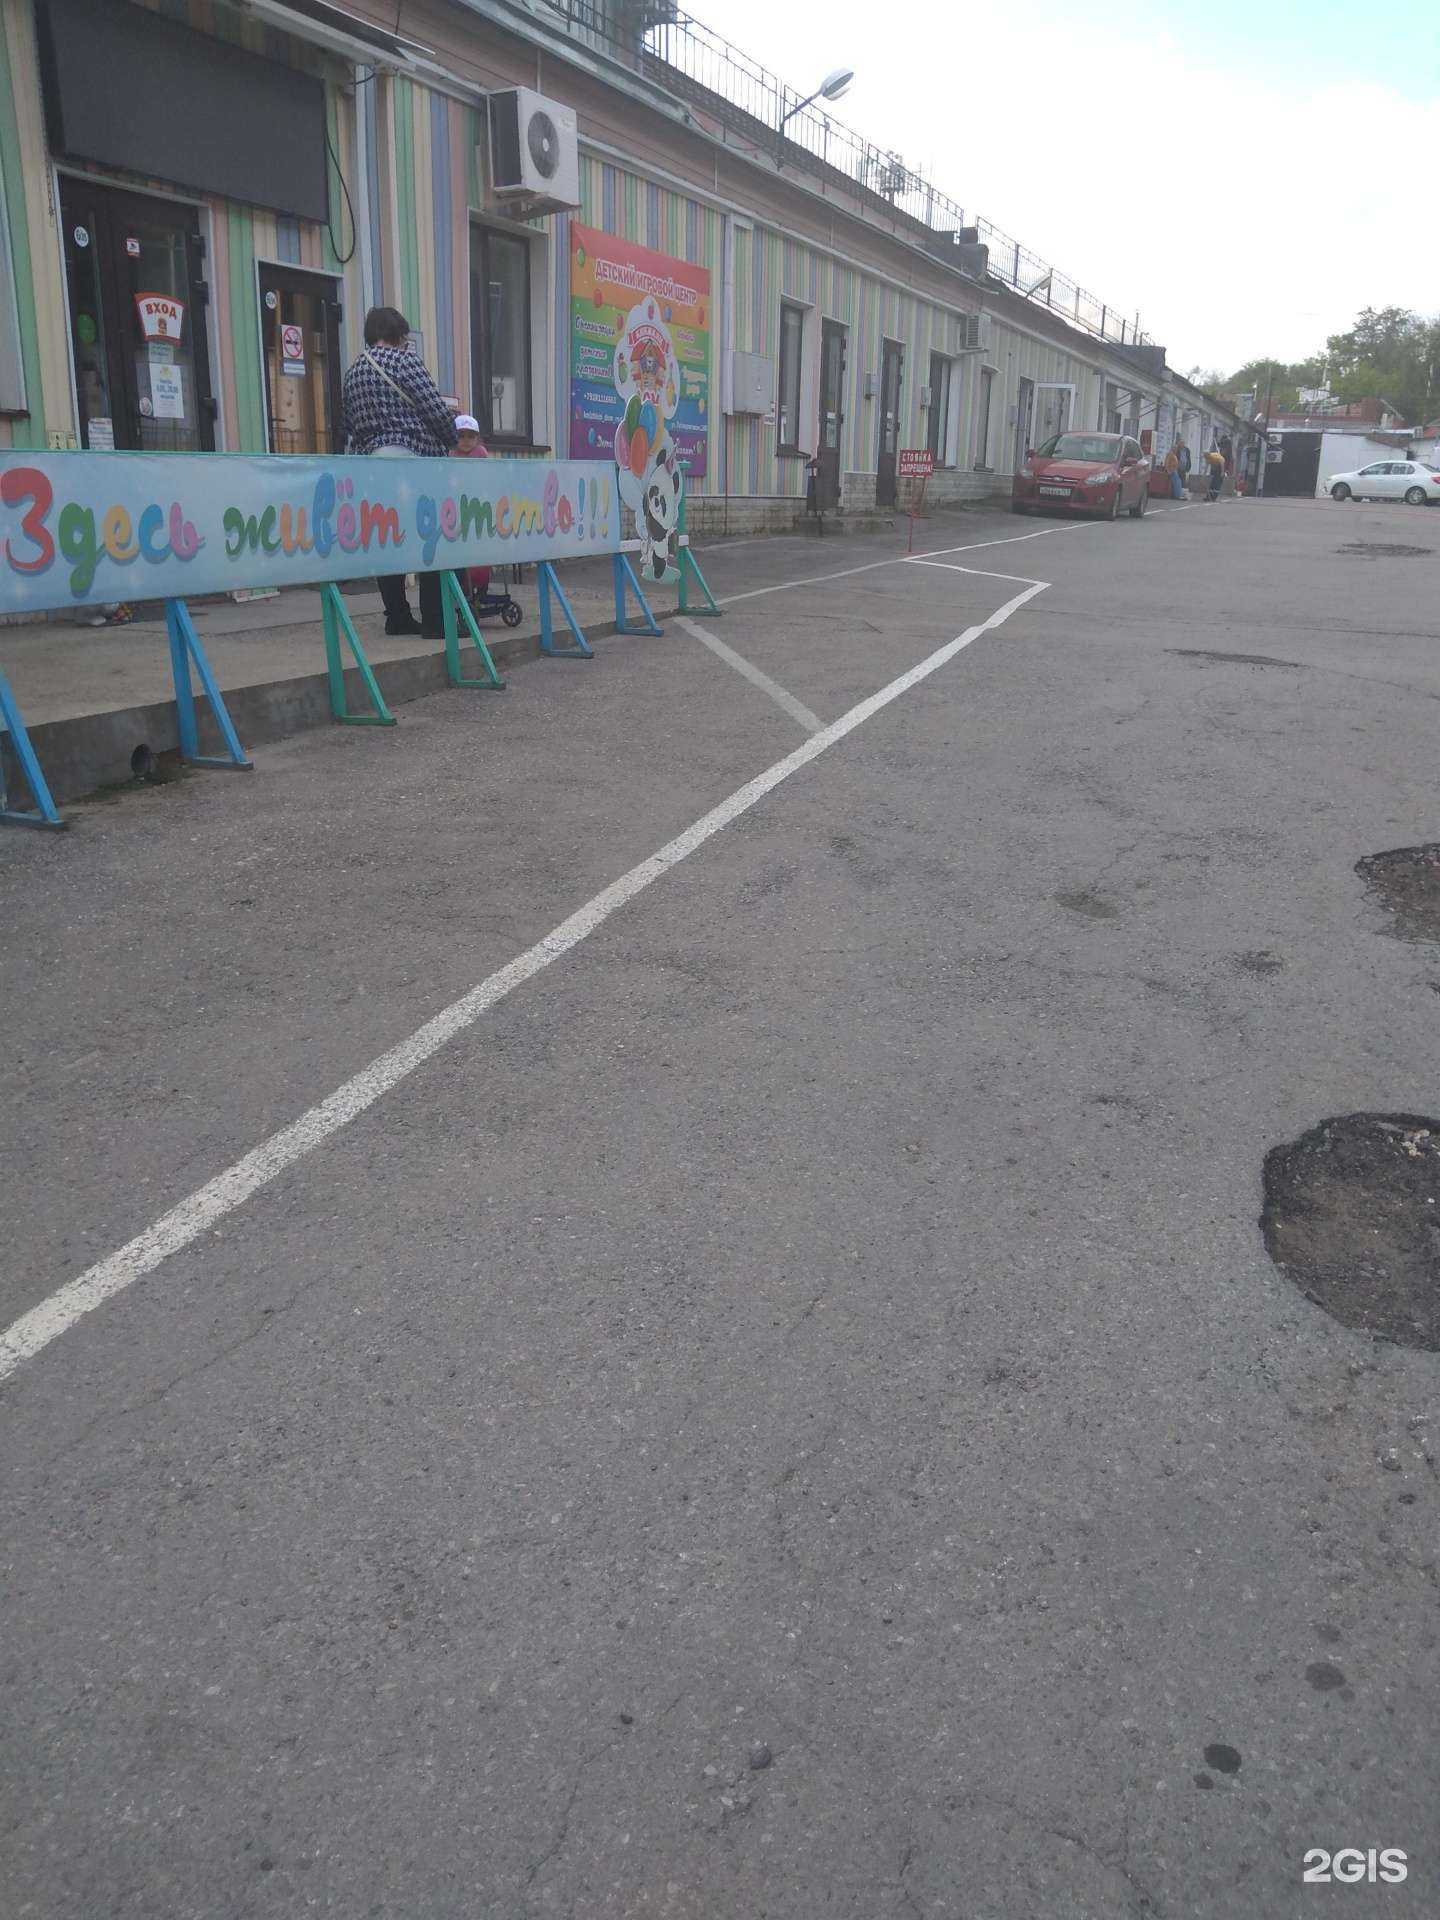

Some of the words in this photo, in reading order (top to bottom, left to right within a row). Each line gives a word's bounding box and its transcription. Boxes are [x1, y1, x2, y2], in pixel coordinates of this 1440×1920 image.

[595, 259, 636, 289] ДЕТСКИЙ
[636, 271, 673, 298] ИГРОВОЙ
[674, 284, 697, 306] ЦЕНТР
[146, 302, 177, 320] ВХОД
[902, 452, 931, 462] СТОЯНКА
[0, 467, 206, 597] Здесь
[223, 472, 406, 560] живёт
[416, 469, 609, 566] детство!!!
